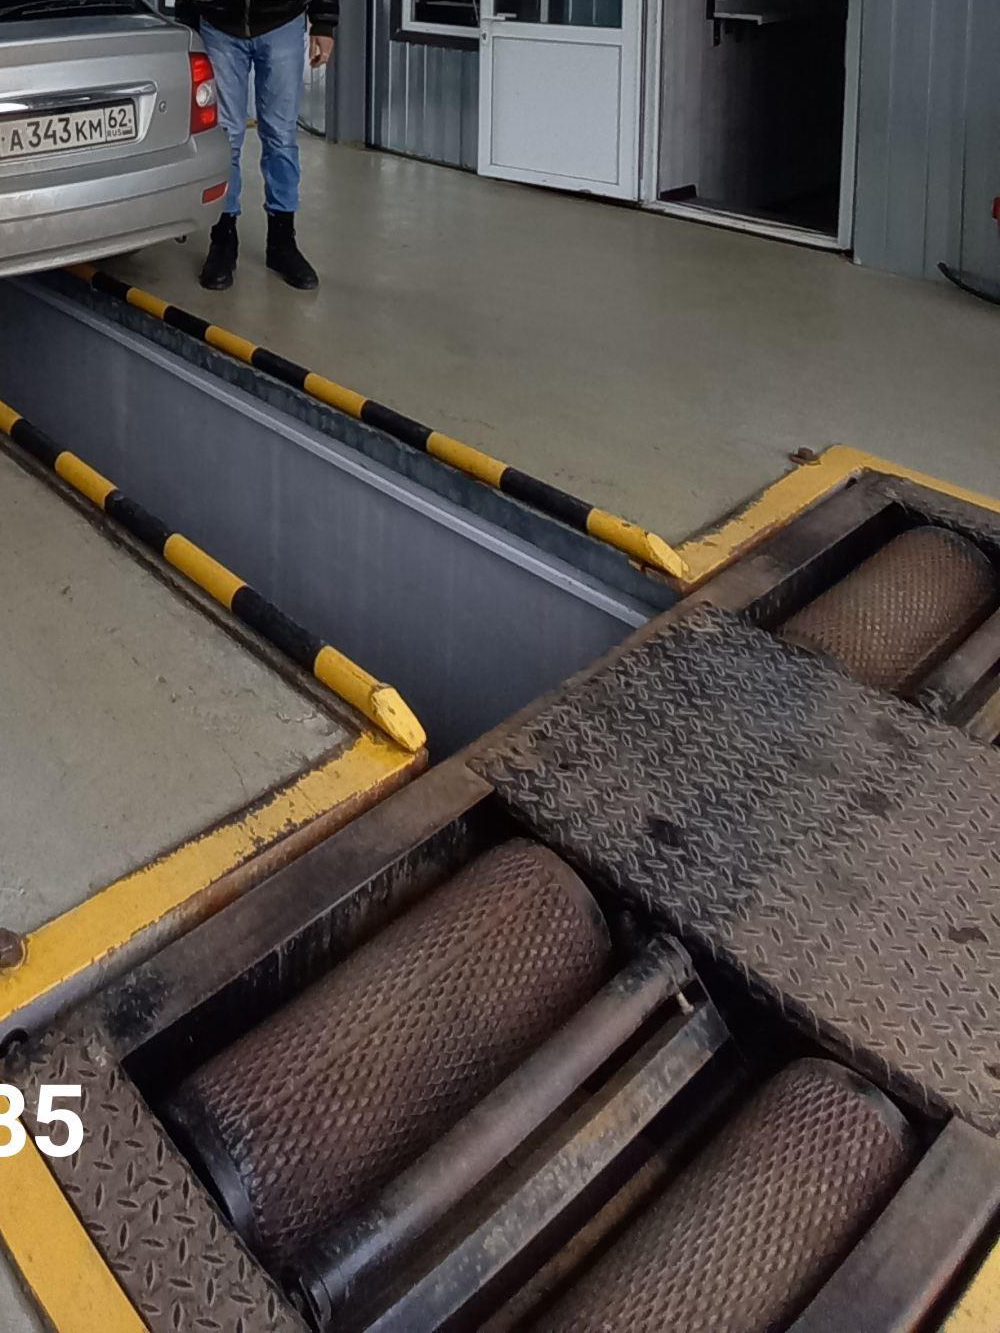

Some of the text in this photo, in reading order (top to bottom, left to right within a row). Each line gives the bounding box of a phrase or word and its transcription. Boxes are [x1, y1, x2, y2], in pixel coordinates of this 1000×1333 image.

[9, 108, 127, 152] А343КМ 62
[107, 129, 122, 137] RUS
